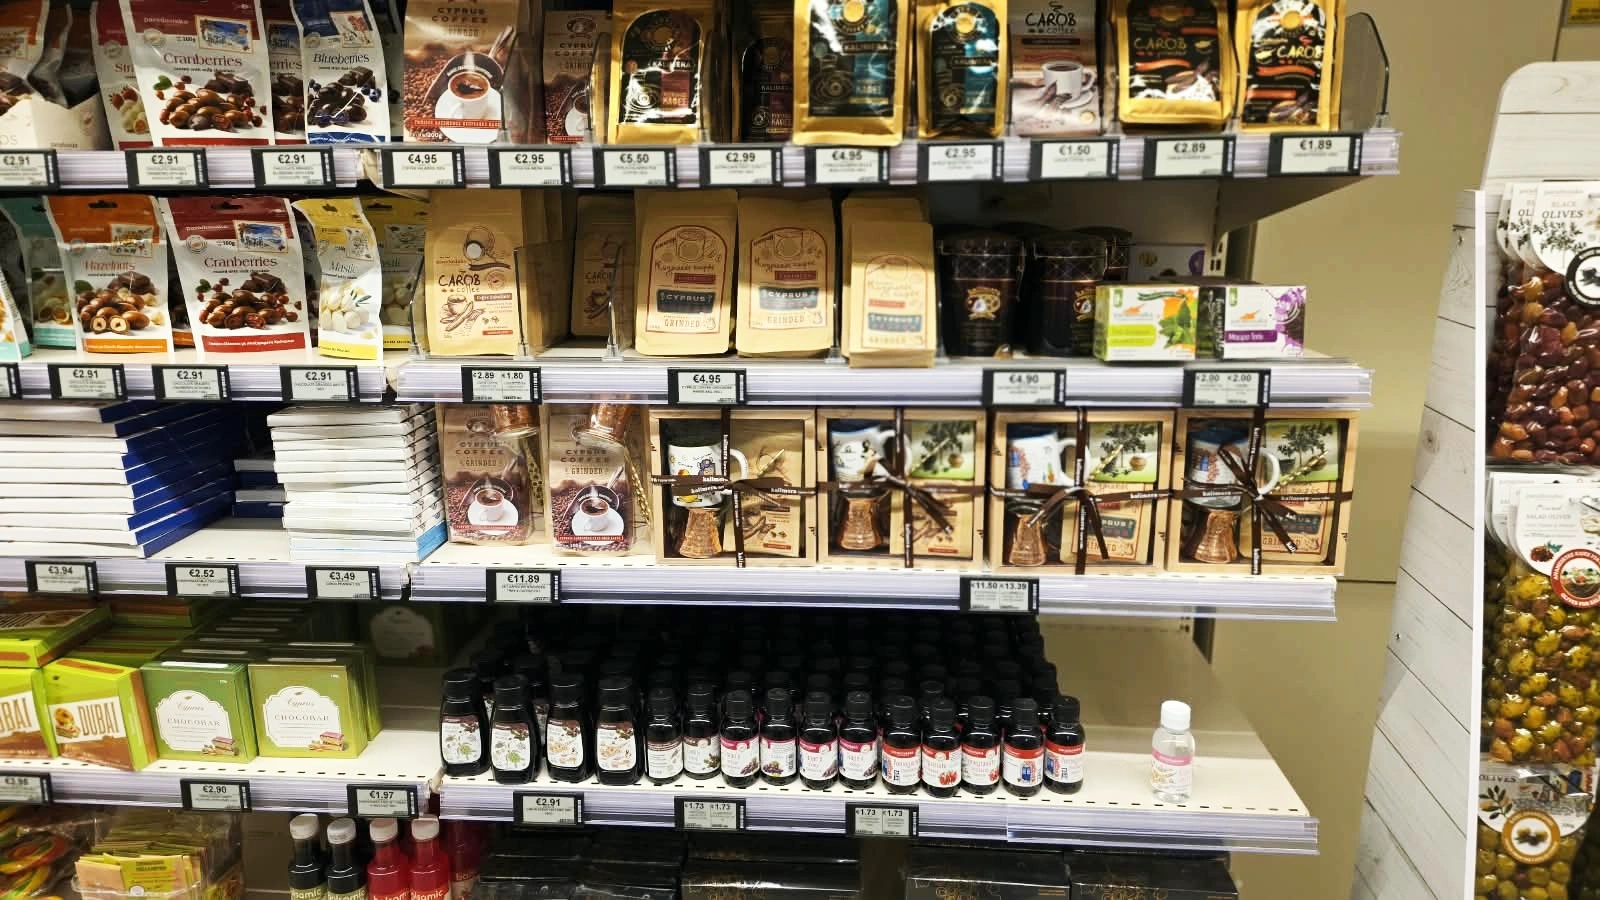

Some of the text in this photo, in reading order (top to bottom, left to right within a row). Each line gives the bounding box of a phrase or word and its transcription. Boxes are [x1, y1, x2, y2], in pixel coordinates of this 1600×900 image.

[431, 15, 488, 24] COFFEE
[1025, 12, 1077, 27] CAROB
[1134, 38, 1188, 50] CAROB
[1277, 45, 1324, 59] CAROB
[163, 52, 243, 67] Cranberries
[313, 52, 371, 66] Blueberries
[1059, 145, 1091, 156] €1.50
[1174, 143, 1206, 154] €2.89
[277, 154, 306, 164] €2.91
[408, 154, 437, 164] €4.95
[619, 154, 650, 164] €5.50
[726, 153, 756, 163] €2.99
[832, 151, 863, 161] €4.95
[945, 148, 976, 160] €2.95
[3, 155, 30, 166] €2.91
[151, 155, 179, 166] €2.91
[515, 154, 545, 165] €2.95
[1541, 209, 1590, 220] OLIVES
[83, 259, 136, 272] Hazelnuts
[204, 256, 278, 269] Cranberries
[438, 273, 481, 287] CAROB
[666, 294, 707, 303] CYPRUS
[767, 291, 809, 299] CYPRUS
[664, 318, 701, 329] GRINDED
[72, 370, 99, 379] €2.91
[177, 370, 204, 380] €2.91
[306, 372, 333, 381] €2.91
[693, 374, 721, 384] €4.95
[1009, 374, 1040, 384] €4.90
[48, 566, 74, 575] €3.94
[188, 569, 215, 578] €2.52
[507, 574, 540, 583] €11.89
[77, 700, 120, 736] DUBAI
[166, 714, 221, 728] CHOCOBAR
[274, 713, 329, 722] CHOCOBAR
[202, 785, 227, 794] €2.90
[369, 791, 395, 800] €1.97
[535, 798, 560, 807] €2.91
